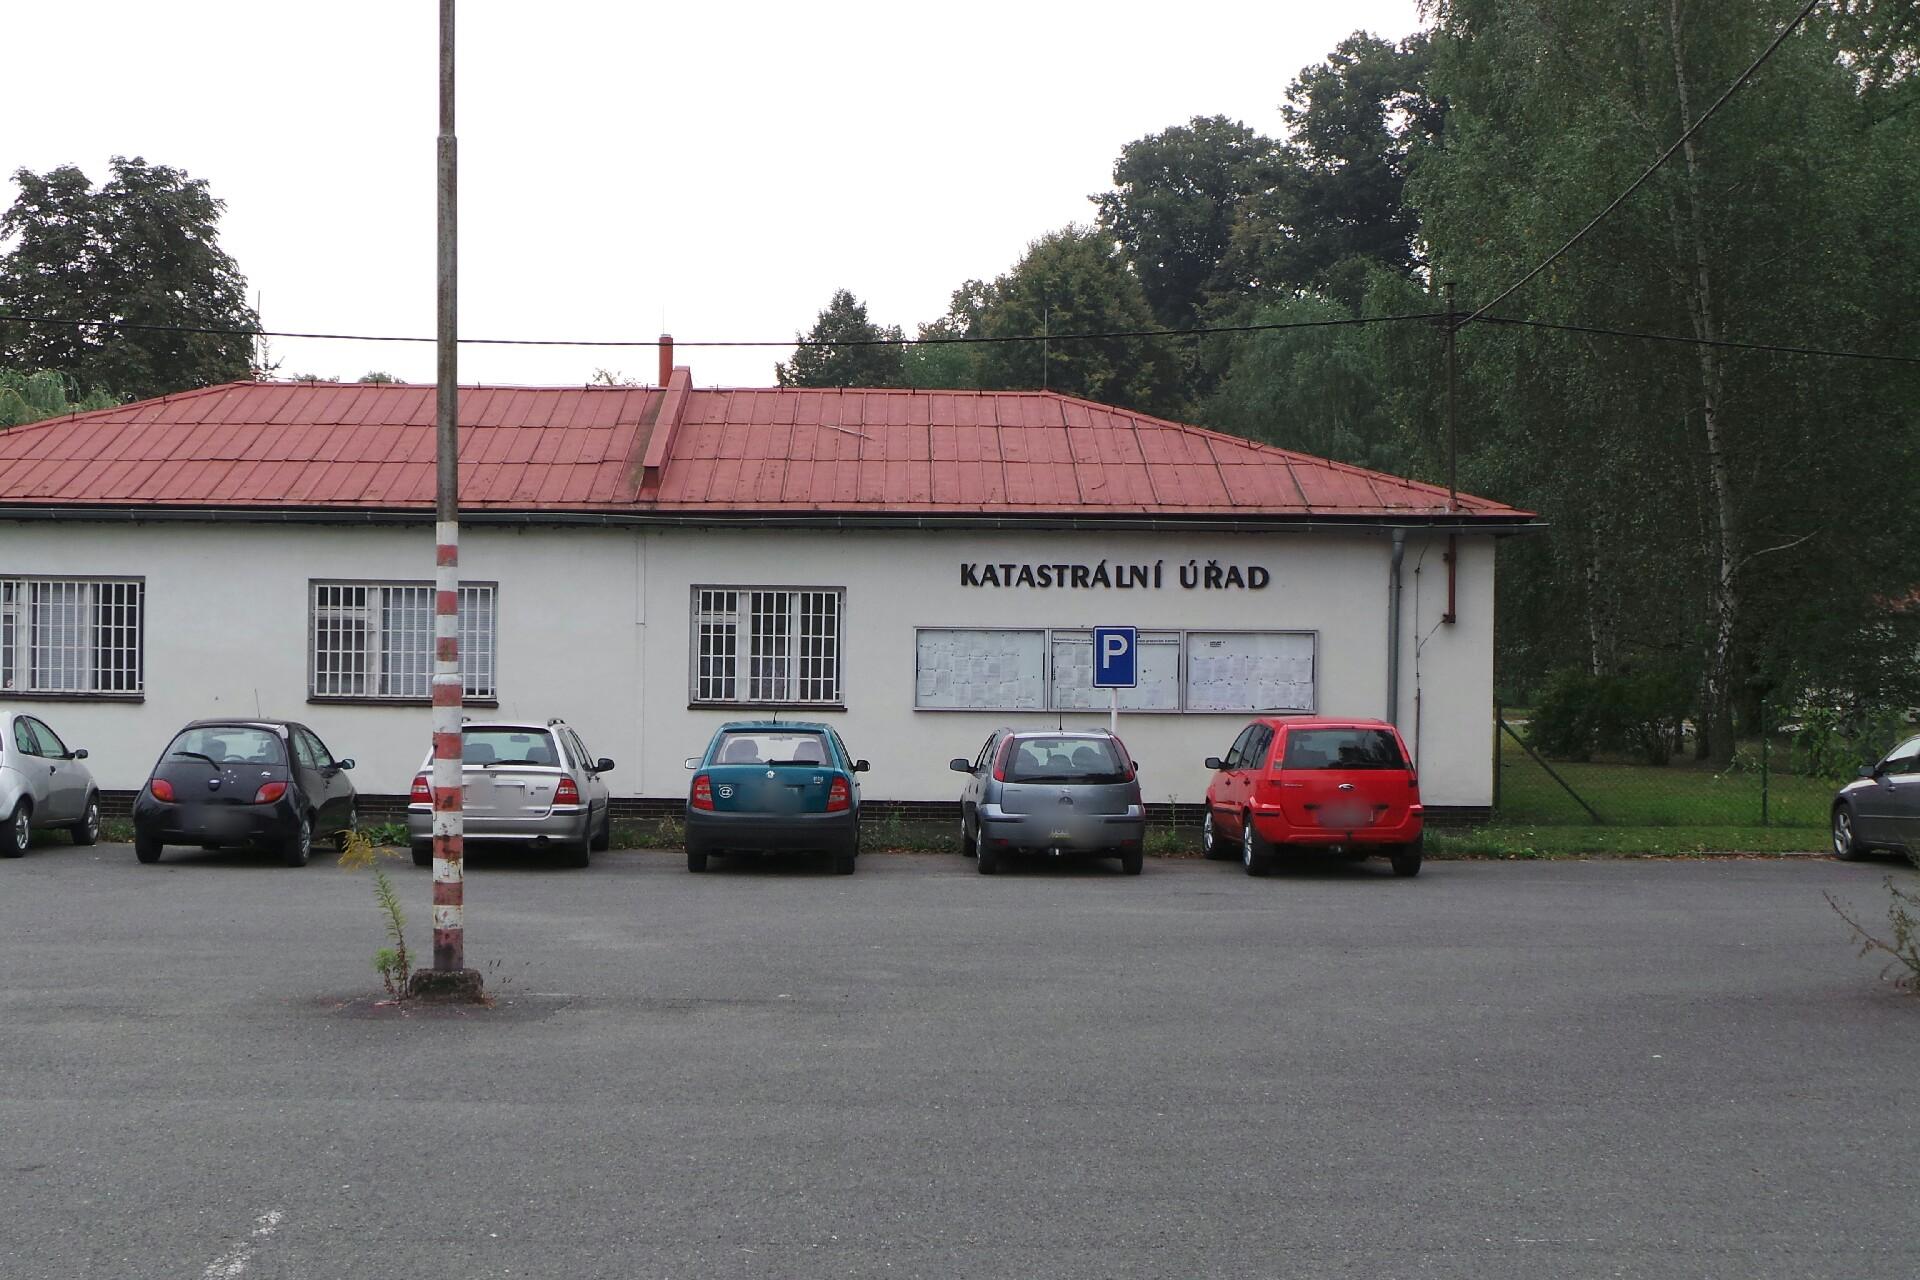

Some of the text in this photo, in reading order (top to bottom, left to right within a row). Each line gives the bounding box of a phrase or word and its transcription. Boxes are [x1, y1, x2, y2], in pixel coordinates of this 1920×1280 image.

[960, 559, 1270, 589] KATASTRÁLNÍ ÚŘAD
[1103, 634, 1128, 669] P
